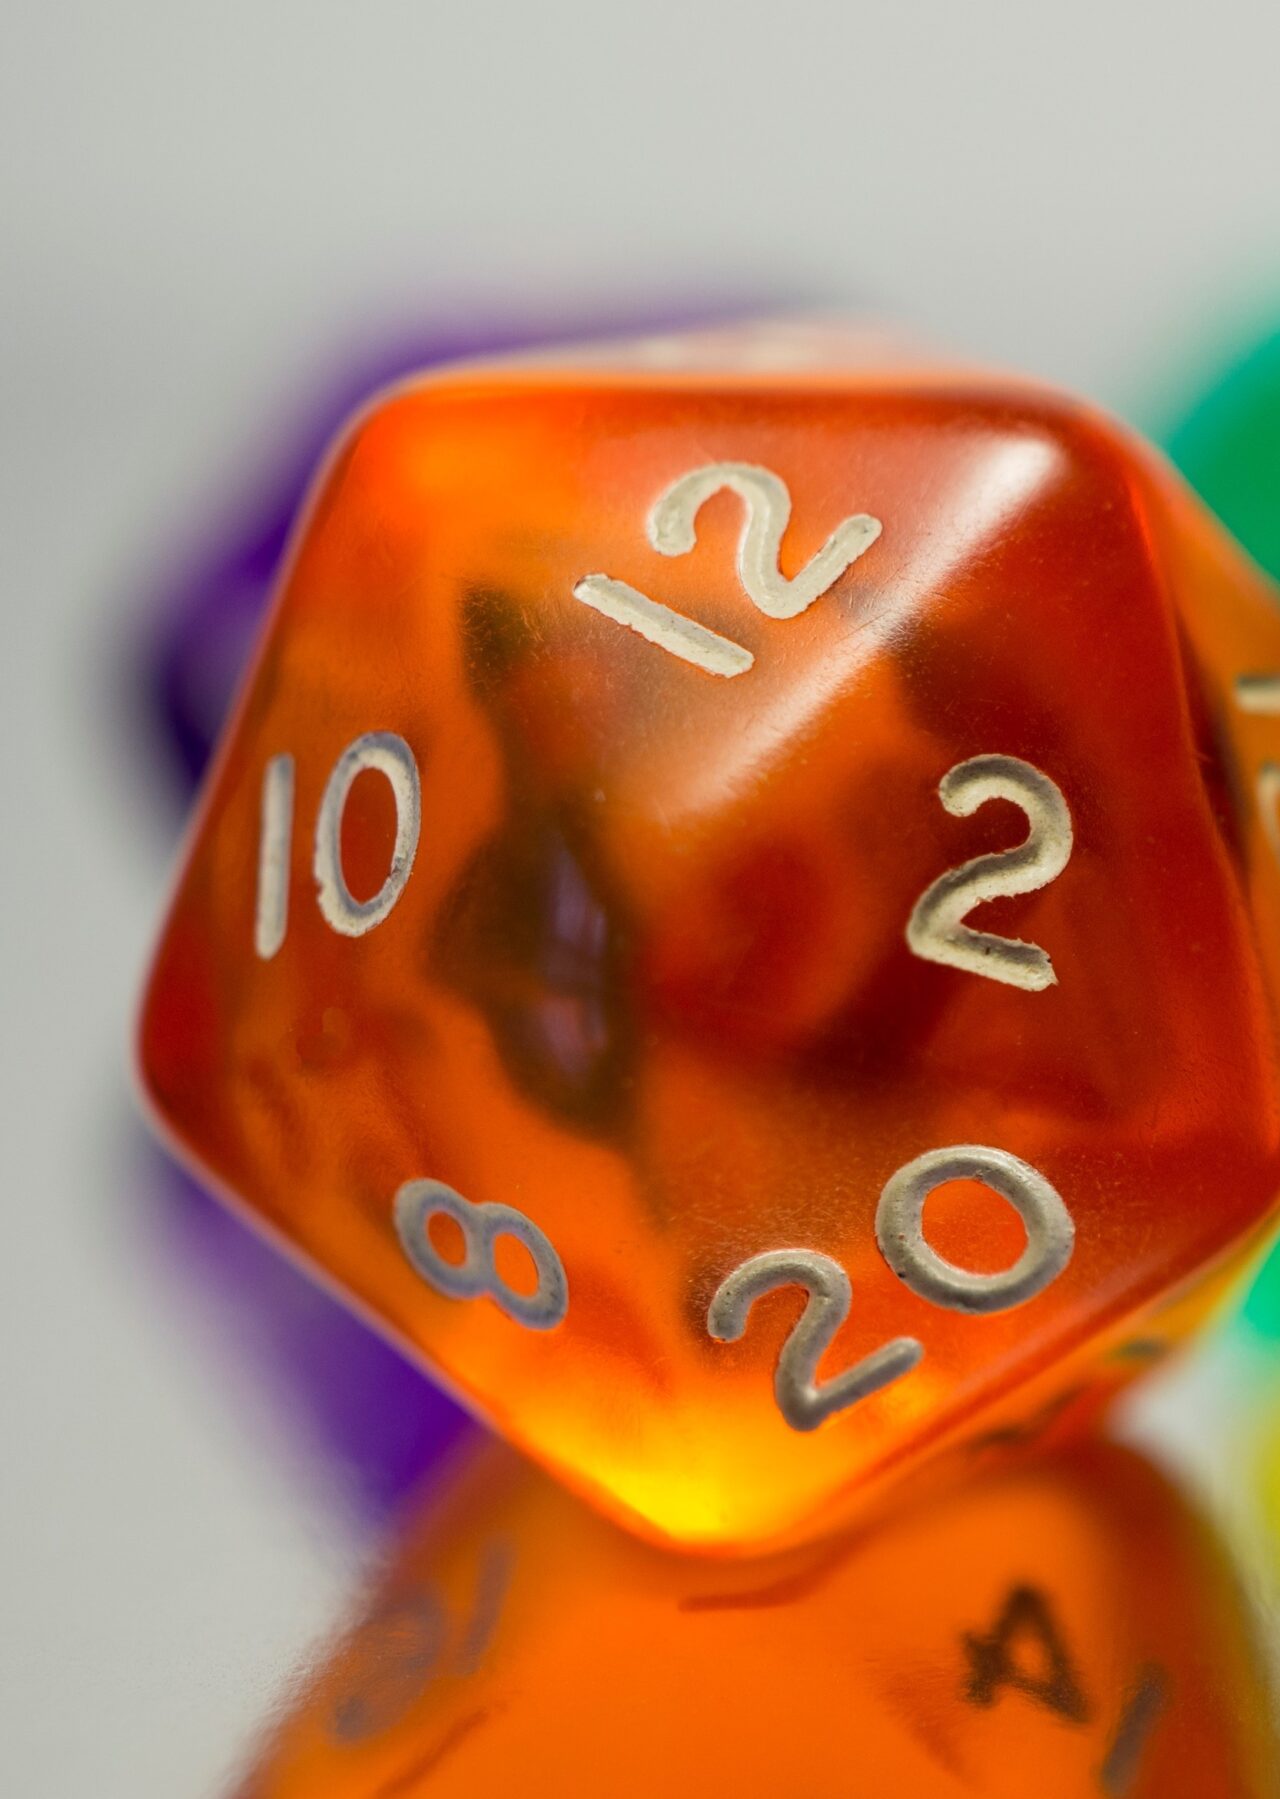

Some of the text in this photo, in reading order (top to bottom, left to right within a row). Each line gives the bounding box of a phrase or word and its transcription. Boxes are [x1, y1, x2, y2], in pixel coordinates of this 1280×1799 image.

[571, 460, 882, 678] 12
[255, 730, 421, 960] 10
[906, 752, 1074, 992] 2
[394, 1178, 568, 1330] 8
[706, 1144, 1075, 1431] 20
